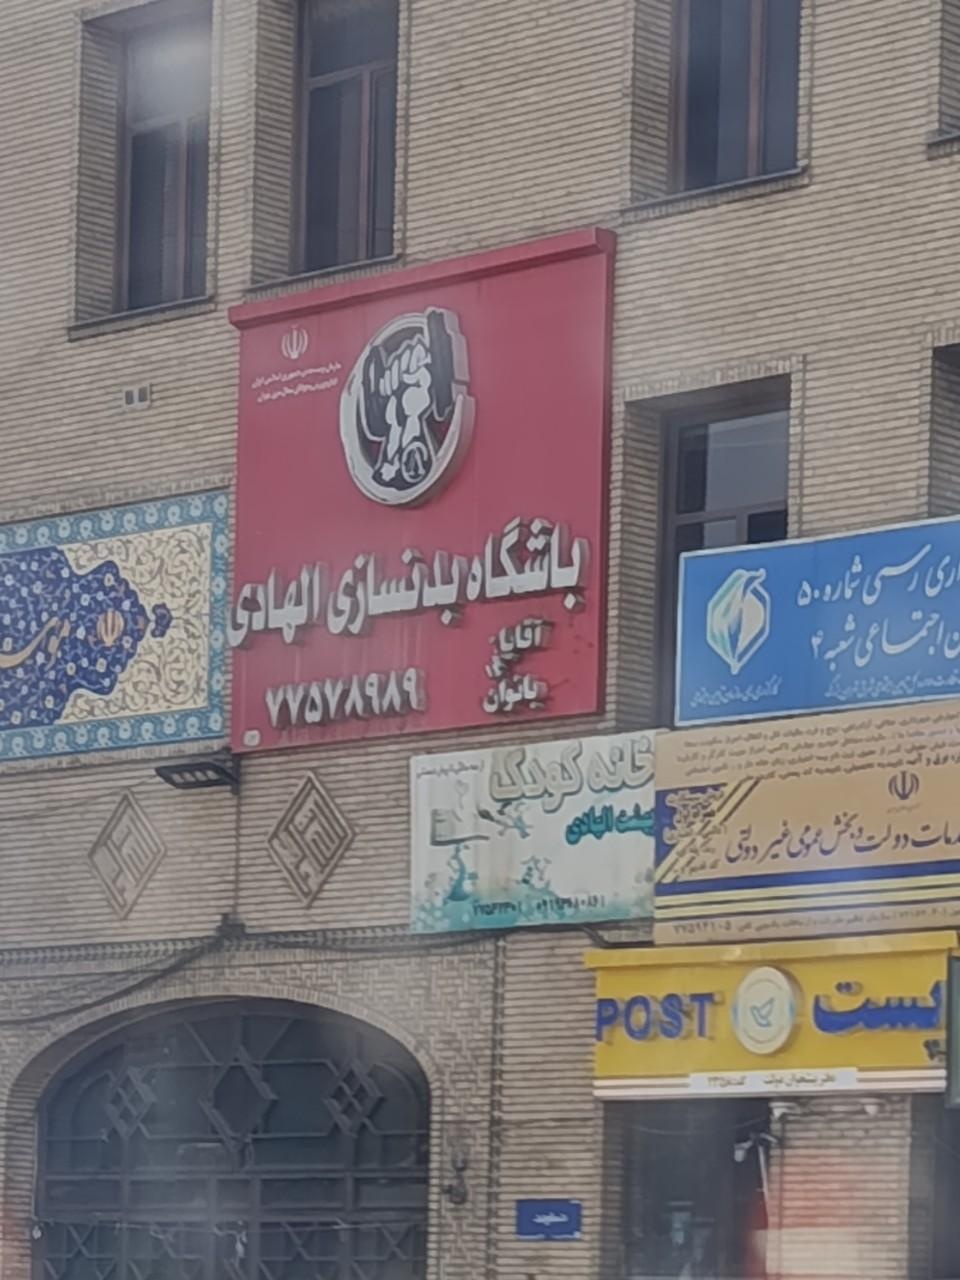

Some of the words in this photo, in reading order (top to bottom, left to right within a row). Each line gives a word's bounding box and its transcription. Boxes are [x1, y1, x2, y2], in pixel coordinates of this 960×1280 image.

[327, 549, 462, 634] بدنسازی
[466, 517, 586, 610] باشگاه
[862, 543, 932, 606] رسمی
[226, 564, 323, 648] الهادی
[823, 613, 857, 672] شعبه
[854, 608, 945, 668] اجتماعی
[265, 667, 420, 728] ۷۷۵۷۸۹۸۹
[483, 673, 542, 713] بانوان
[489, 740, 584, 815] کودک
[588, 735, 657, 795] خانه
[725, 823, 759, 865] دولتی
[757, 818, 791, 865] غیر
[787, 824, 823, 859] عمومی
[854, 824, 909, 859] دولت
[595, 991, 716, 1042] POST
